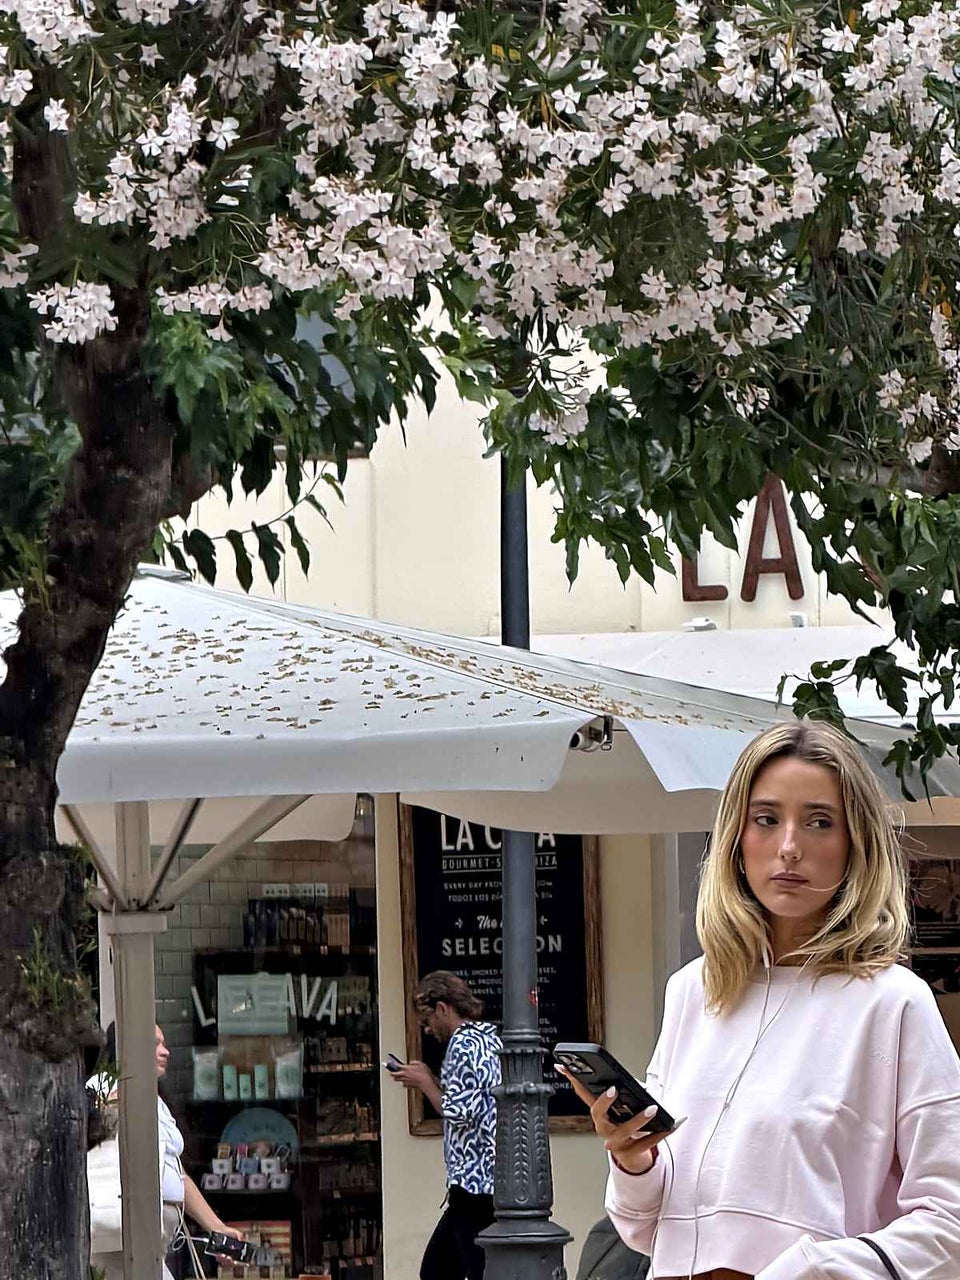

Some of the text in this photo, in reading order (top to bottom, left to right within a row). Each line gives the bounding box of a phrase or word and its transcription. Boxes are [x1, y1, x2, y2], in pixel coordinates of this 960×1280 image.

[440, 814, 557, 851] LA CA
[476, 914, 498, 929] The
[441, 934, 562, 957] SELECON
[257, 971, 338, 1026] AVA
